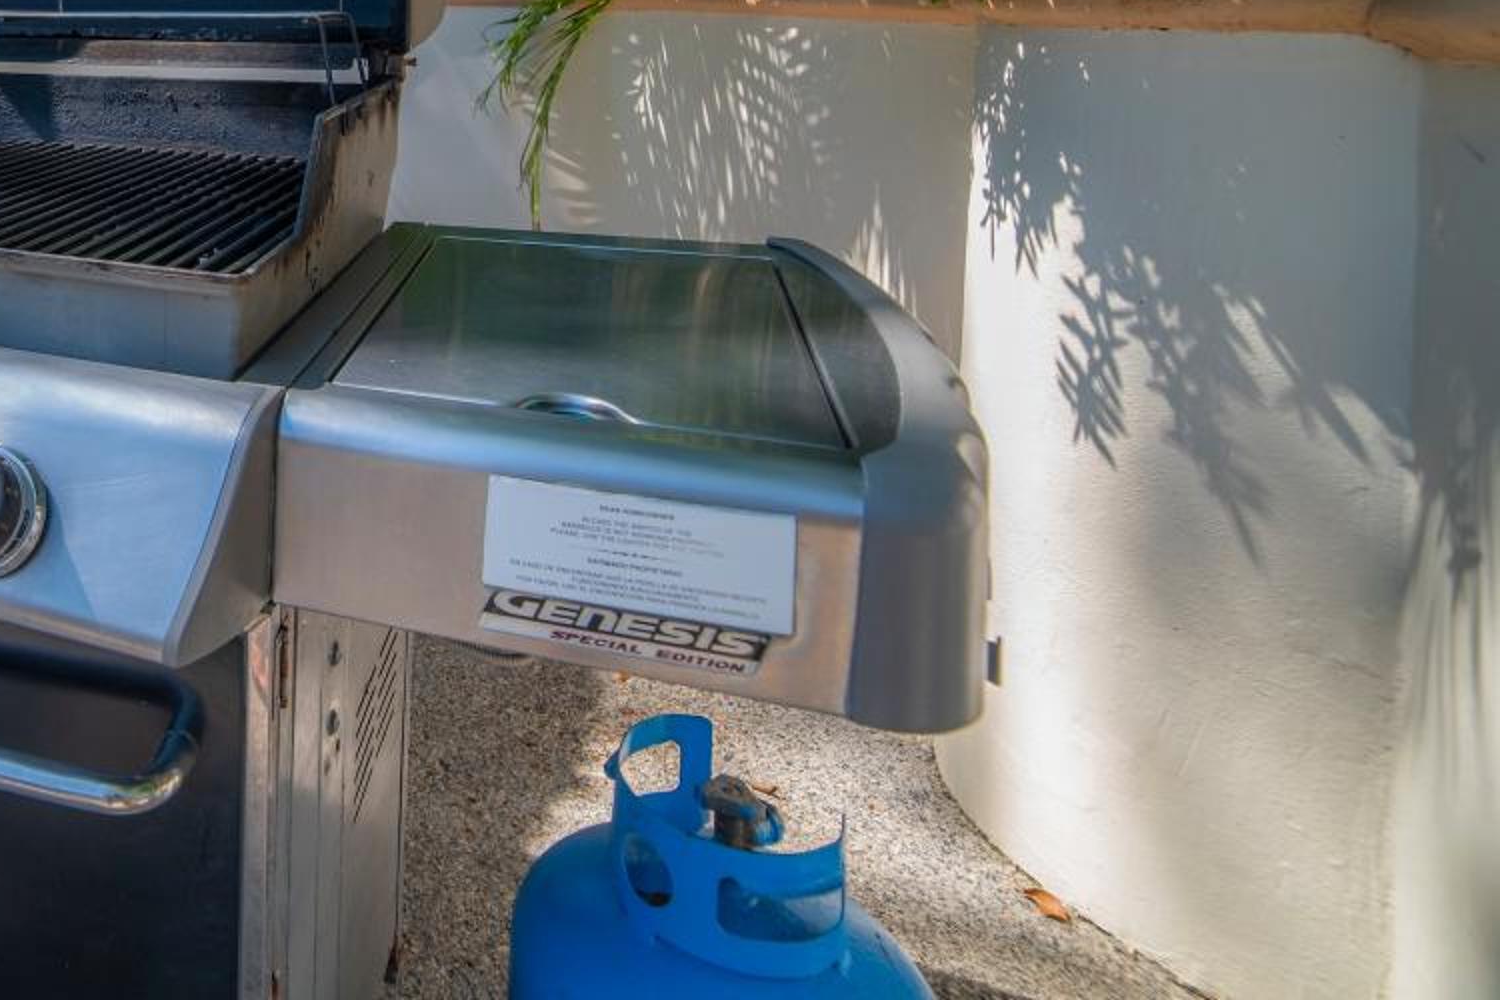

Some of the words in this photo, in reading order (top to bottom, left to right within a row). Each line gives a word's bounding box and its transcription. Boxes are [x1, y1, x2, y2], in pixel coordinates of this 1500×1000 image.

[492, 590, 766, 657] GENESIS
[550, 629, 643, 655] SPECIAL
[655, 649, 747, 674] EDITION
